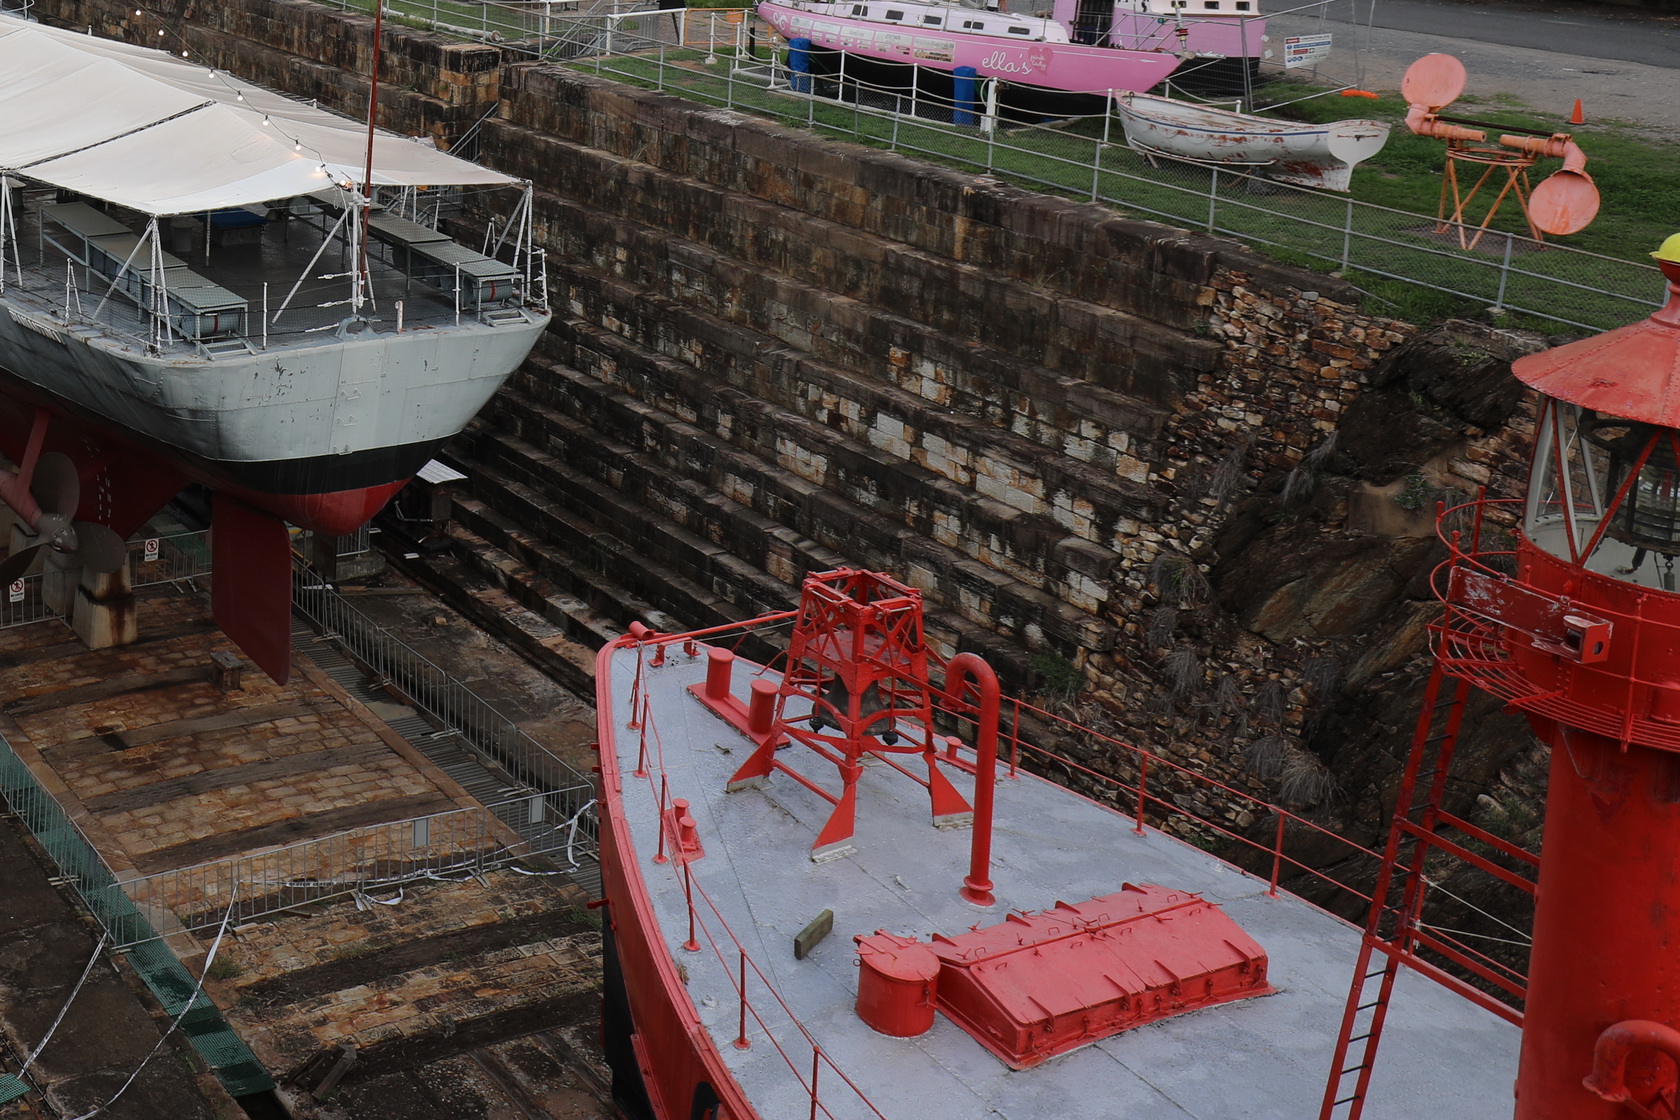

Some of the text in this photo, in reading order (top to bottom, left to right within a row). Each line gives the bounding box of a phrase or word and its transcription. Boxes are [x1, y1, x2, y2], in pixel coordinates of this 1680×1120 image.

[982, 51, 1032, 75] ella's
[1030, 54, 1046, 62] pink
[1031, 60, 1047, 70] lady
